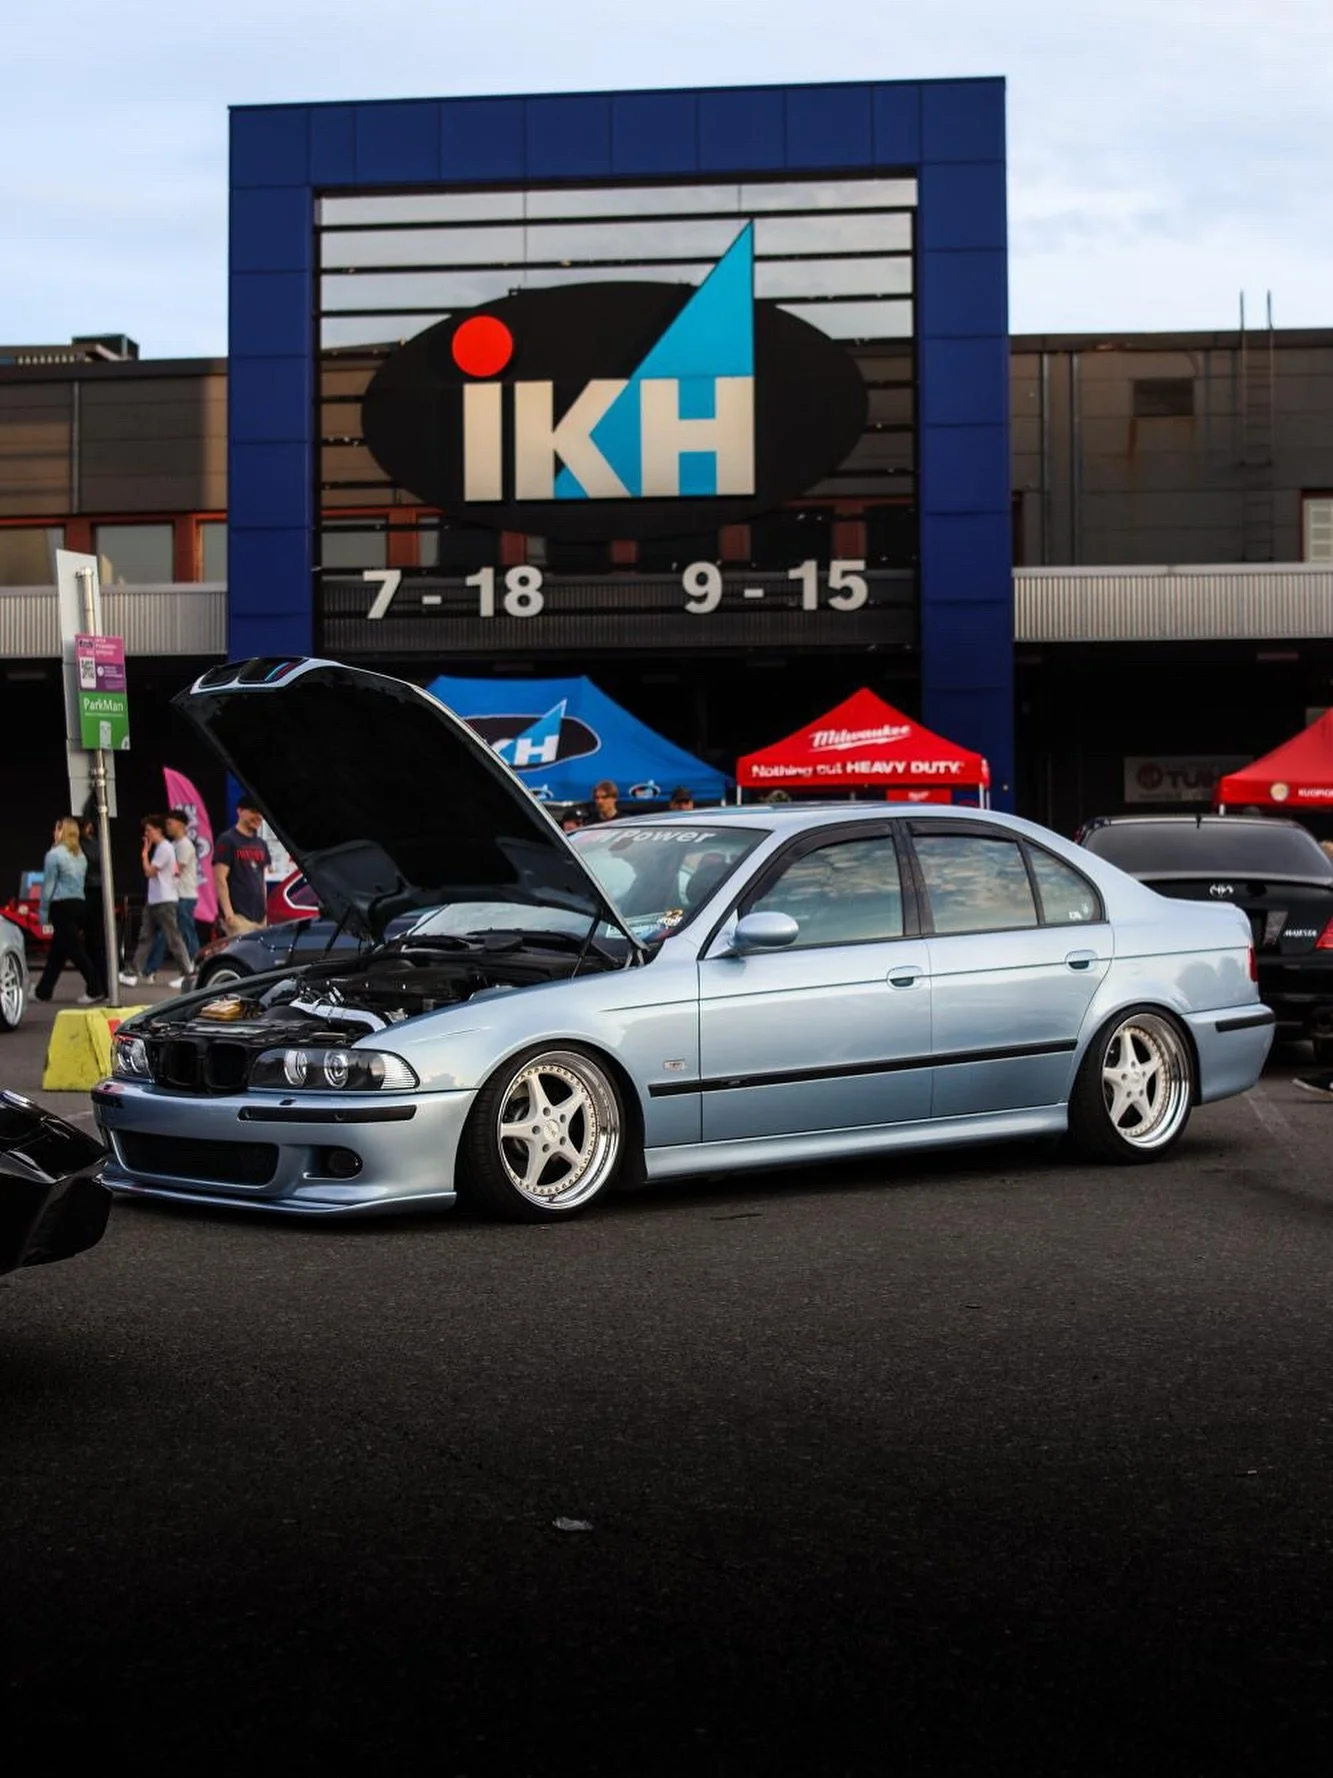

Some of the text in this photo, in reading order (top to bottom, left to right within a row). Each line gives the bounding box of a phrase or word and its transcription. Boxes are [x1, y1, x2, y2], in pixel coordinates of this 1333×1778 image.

[362, 569, 402, 619] 7
[465, 565, 545, 617] 18
[682, 561, 723, 614] 9
[787, 559, 868, 610] 15
[83, 696, 124, 712] ParkMan
[809, 724, 911, 750] Milwaukee
[752, 764, 813, 779] Nothing
[846, 760, 909, 774] HEAVY
